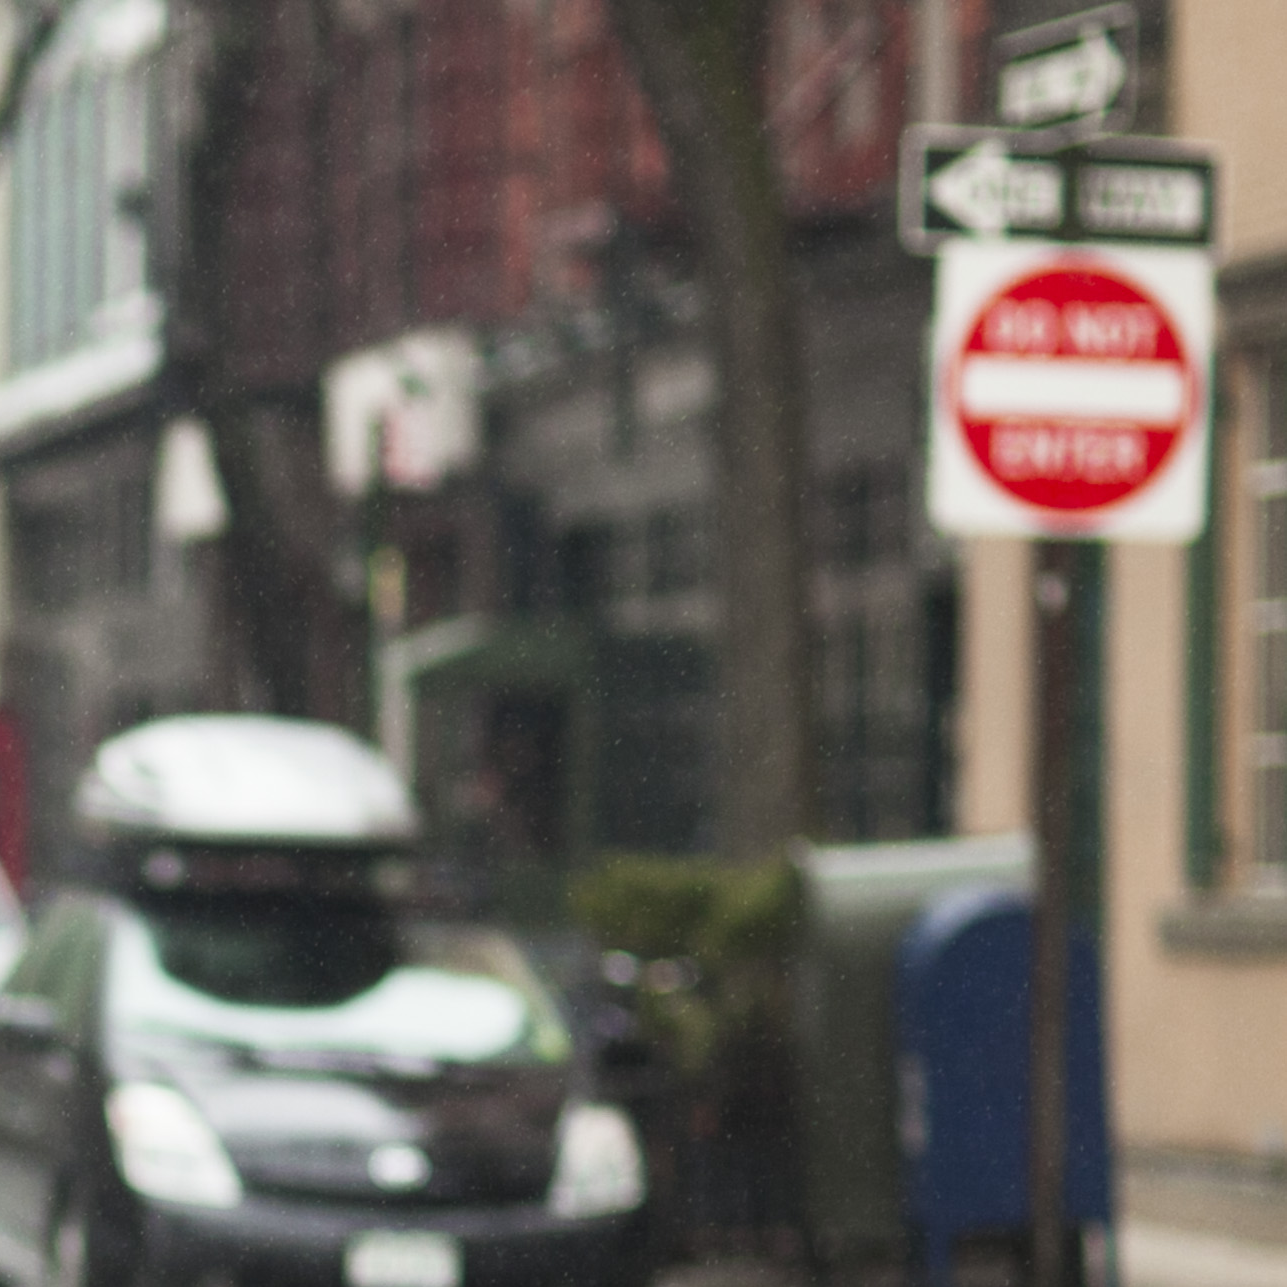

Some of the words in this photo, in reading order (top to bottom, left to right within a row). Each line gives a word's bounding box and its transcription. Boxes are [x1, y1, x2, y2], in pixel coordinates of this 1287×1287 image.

[983, 298, 1058, 355] DO
[1062, 301, 1158, 358] NOT
[990, 426, 1148, 483] ENTER
